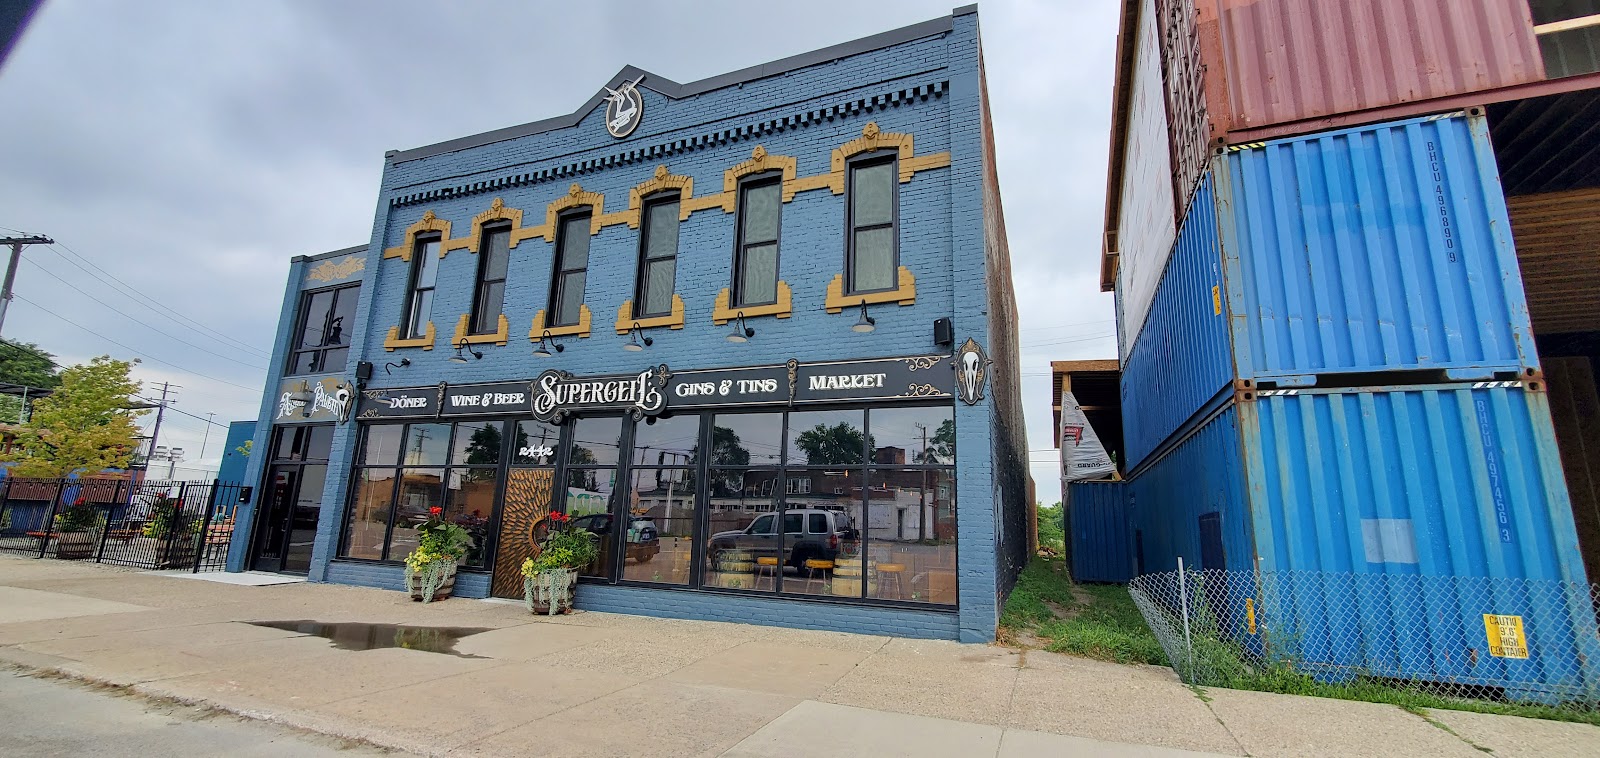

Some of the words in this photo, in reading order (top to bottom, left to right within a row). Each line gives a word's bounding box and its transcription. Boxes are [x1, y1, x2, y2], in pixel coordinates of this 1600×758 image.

[1427, 141, 1442, 182] BHCU
[1435, 185, 1454, 249] 496890
[1449, 252, 1457, 263] 9
[675, 382, 716, 397] GINS
[718, 379, 733, 396] &
[736, 378, 778, 395] TINS
[808, 373, 886, 391] MARKET
[389, 394, 428, 409] DÖNER
[451, 394, 481, 407] WINE
[481, 392, 493, 407] &
[492, 392, 525, 405] BEER
[518, 443, 554, 457] 2442
[1476, 400, 1492, 447] BHCU
[1487, 451, 1508, 524] 497456
